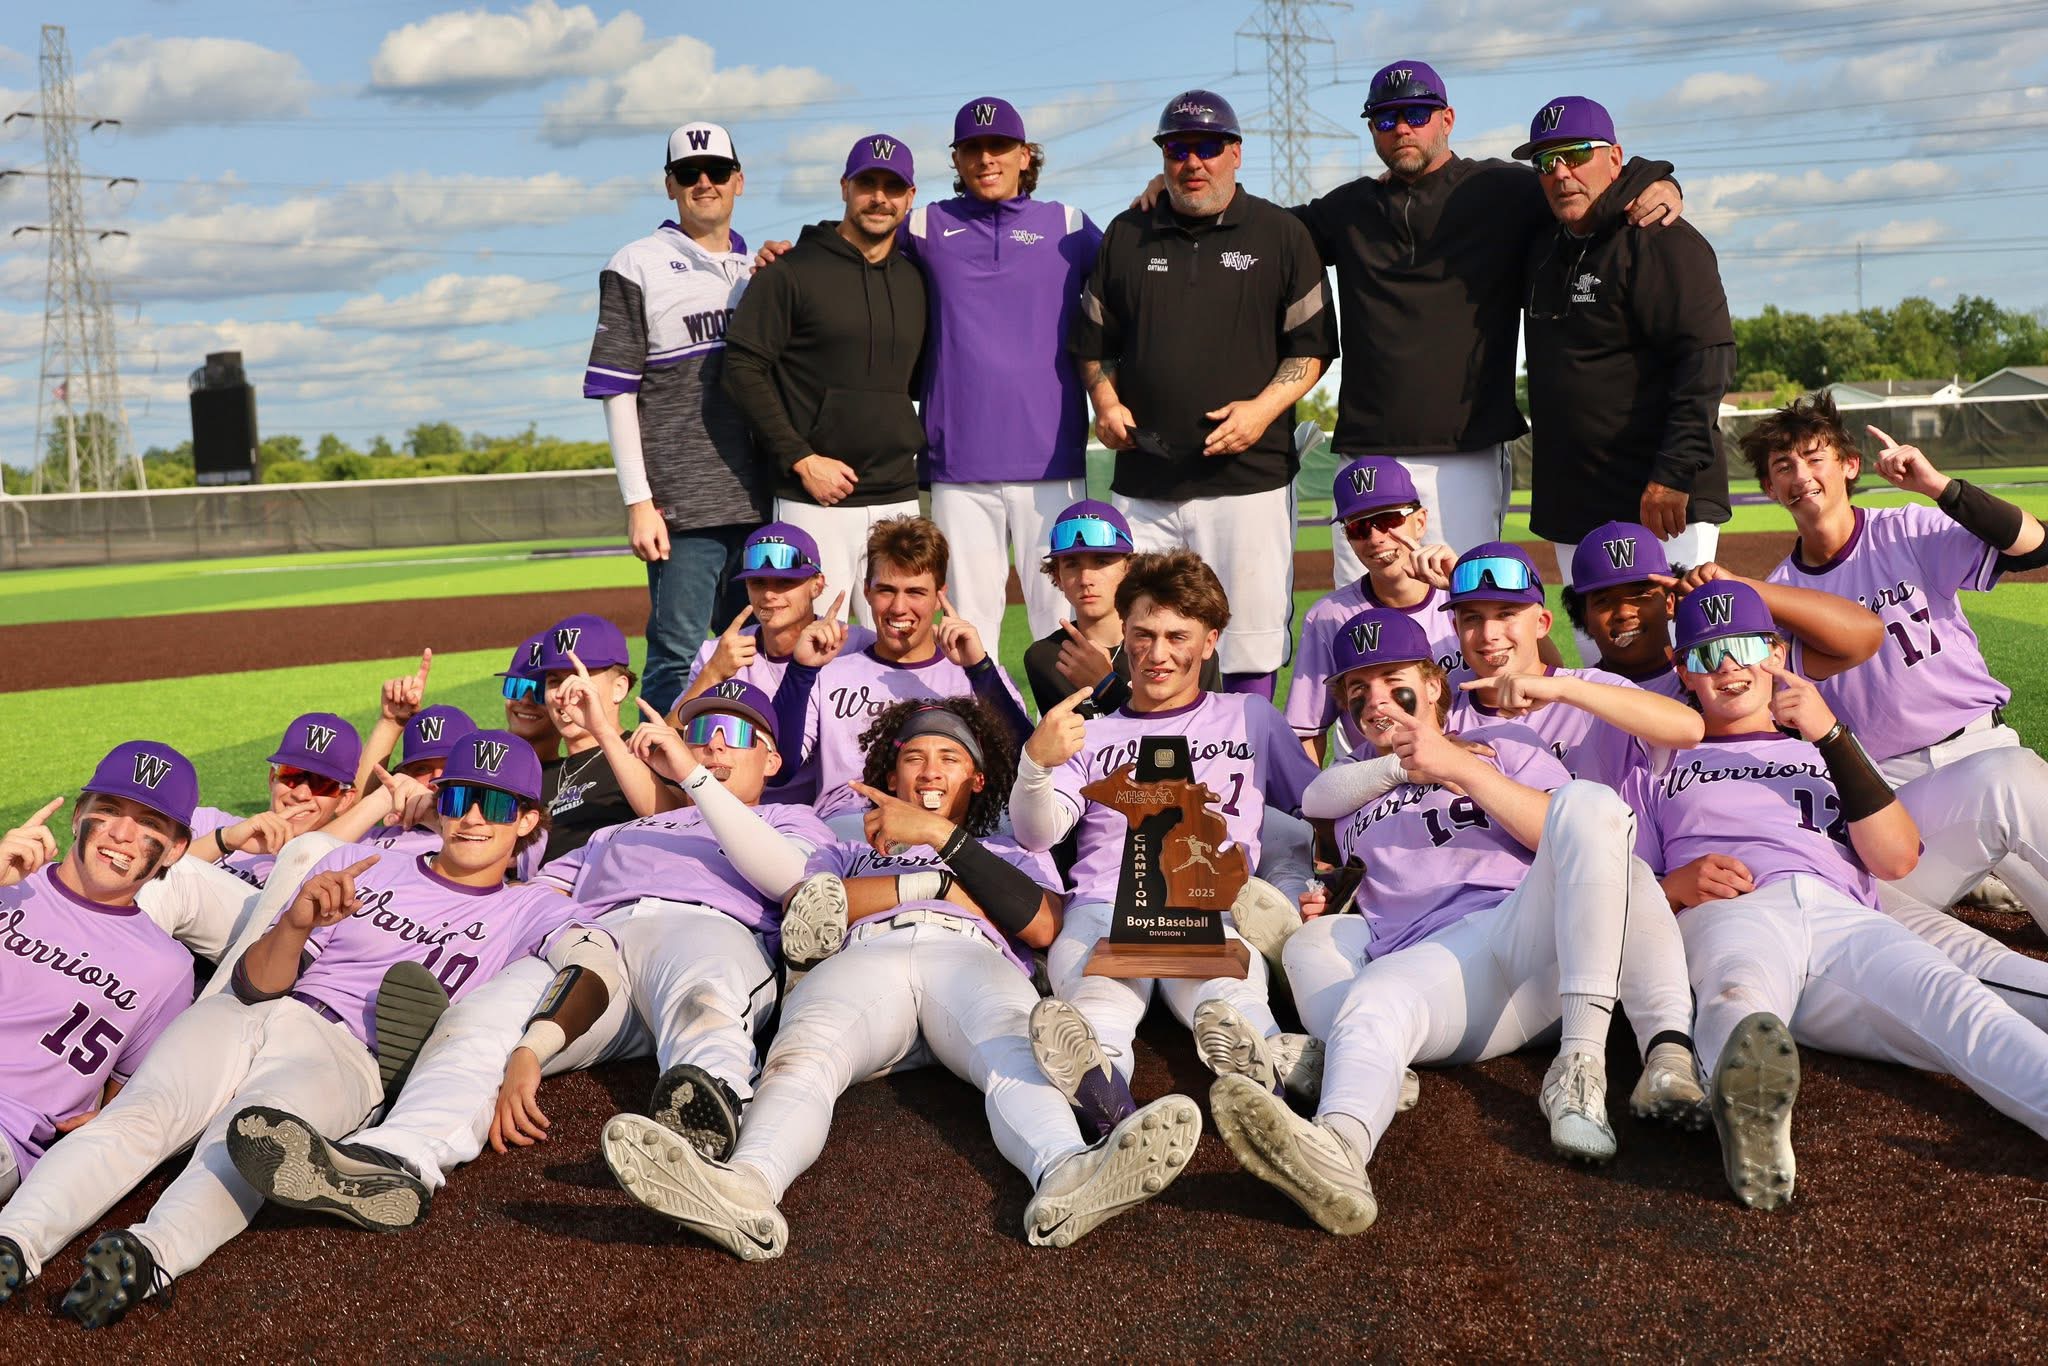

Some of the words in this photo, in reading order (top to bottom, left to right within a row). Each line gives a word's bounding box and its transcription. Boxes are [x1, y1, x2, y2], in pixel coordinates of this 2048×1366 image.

[971, 103, 997, 126] W
[1540, 105, 1565, 133] W
[686, 130, 711, 150] W
[869, 138, 897, 161] W
[1348, 466, 1378, 496] W
[1603, 537, 1637, 571] W
[1698, 592, 1735, 627] W
[554, 628, 582, 655] W
[1348, 621, 1383, 656] W
[1885, 606, 1942, 668] 17
[304, 724, 337, 754] W
[415, 716, 446, 744] W
[133, 752, 172, 789] W
[473, 739, 510, 772] W
[1221, 772, 1246, 818] 1
[1420, 795, 1492, 848] 19
[1792, 788, 1849, 848] 12
[1133, 834, 1148, 908] CHAMPION
[1188, 888, 1216, 898] 2025
[1126, 916, 1156, 929] Boys
[1157, 916, 1209, 928] Baseball
[40, 1001, 126, 1076] 15
